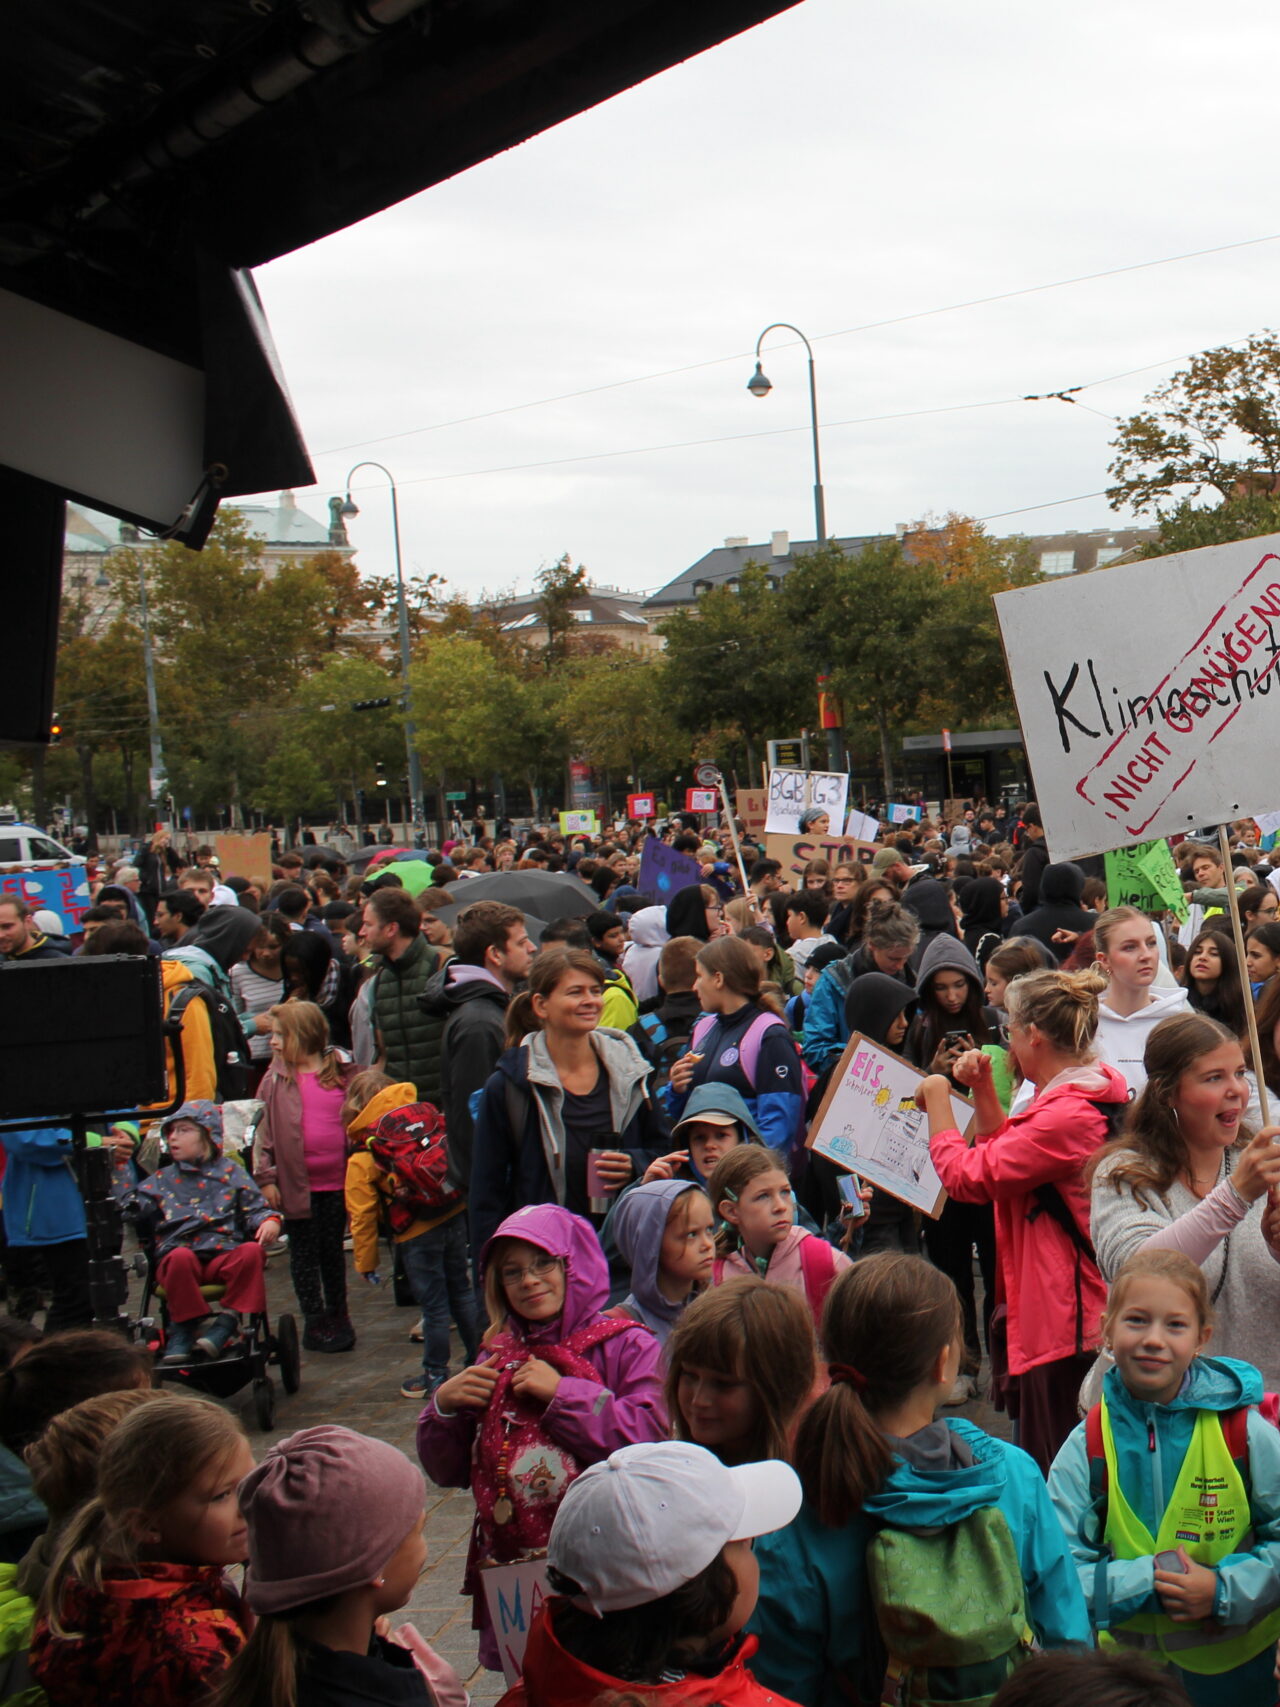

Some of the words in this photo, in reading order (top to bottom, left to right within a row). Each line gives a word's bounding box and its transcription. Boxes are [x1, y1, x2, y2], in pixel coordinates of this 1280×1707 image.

[1103, 731, 1172, 812] NICHT
[791, 842, 877, 875] STOP
[851, 1051, 884, 1089] Eis
[1216, 1508, 1235, 1516] Stadt
[1216, 1516, 1235, 1524] Wien
[497, 1577, 544, 1634] MA
